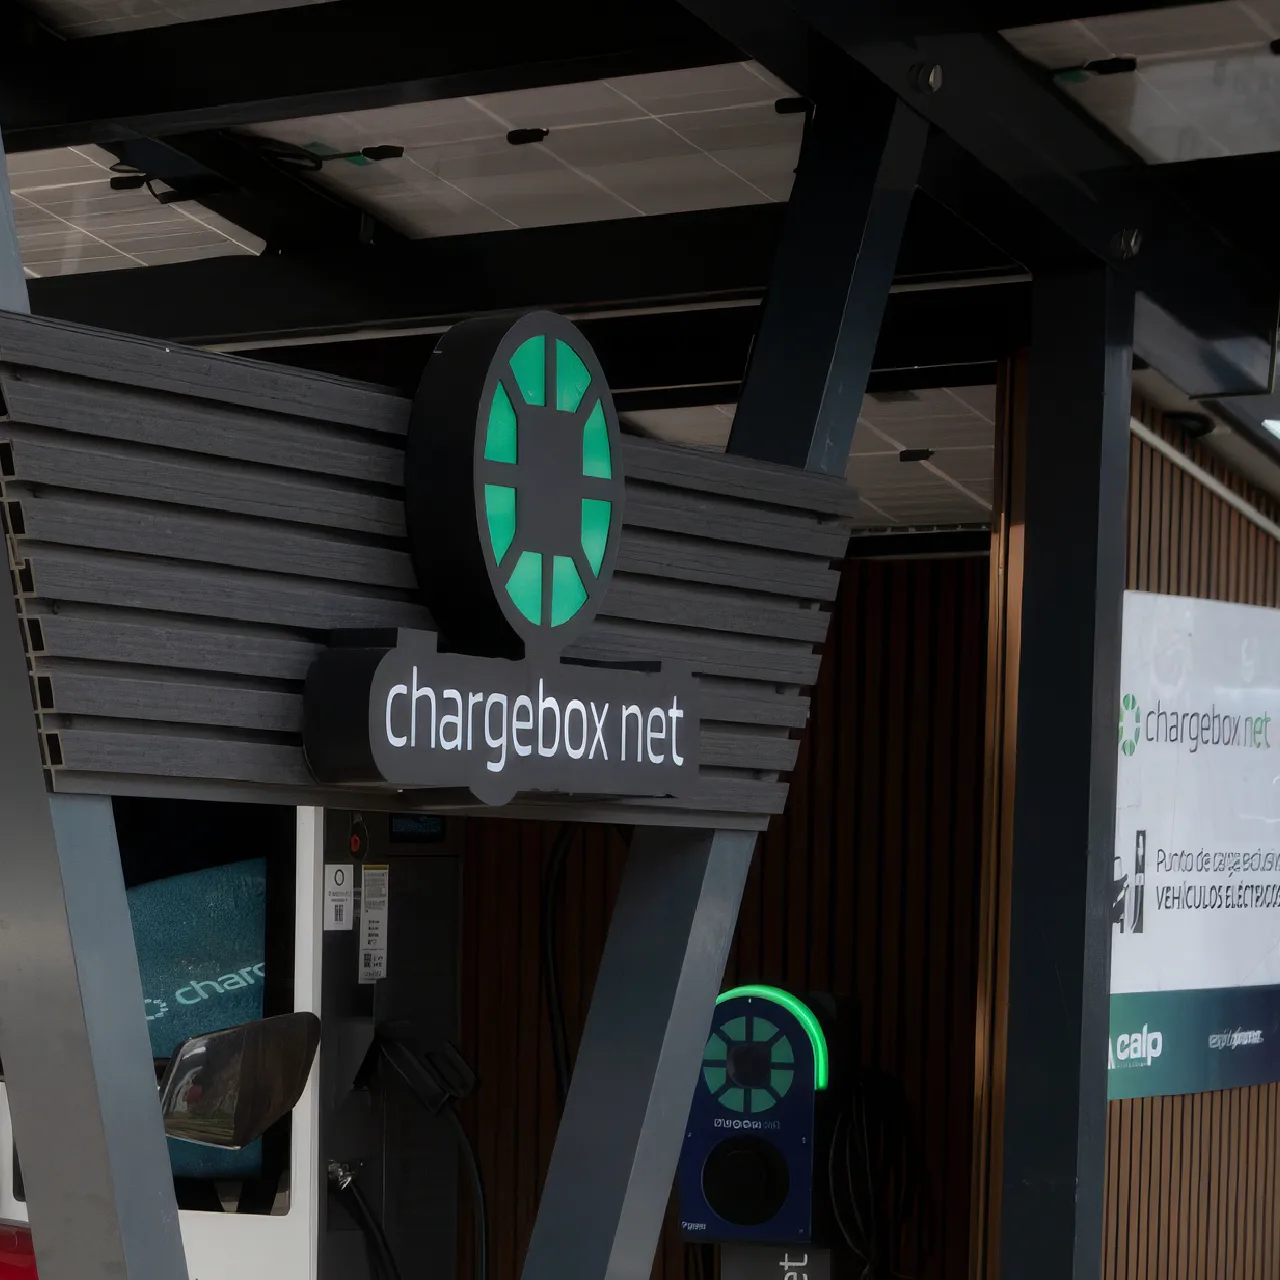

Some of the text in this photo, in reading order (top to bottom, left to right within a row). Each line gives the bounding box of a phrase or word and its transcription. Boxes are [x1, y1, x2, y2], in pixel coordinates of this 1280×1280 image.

[385, 665, 684, 773] chargebox net
[1145, 698, 1272, 753] chargebox net
[1116, 1022, 1163, 1067] calp
